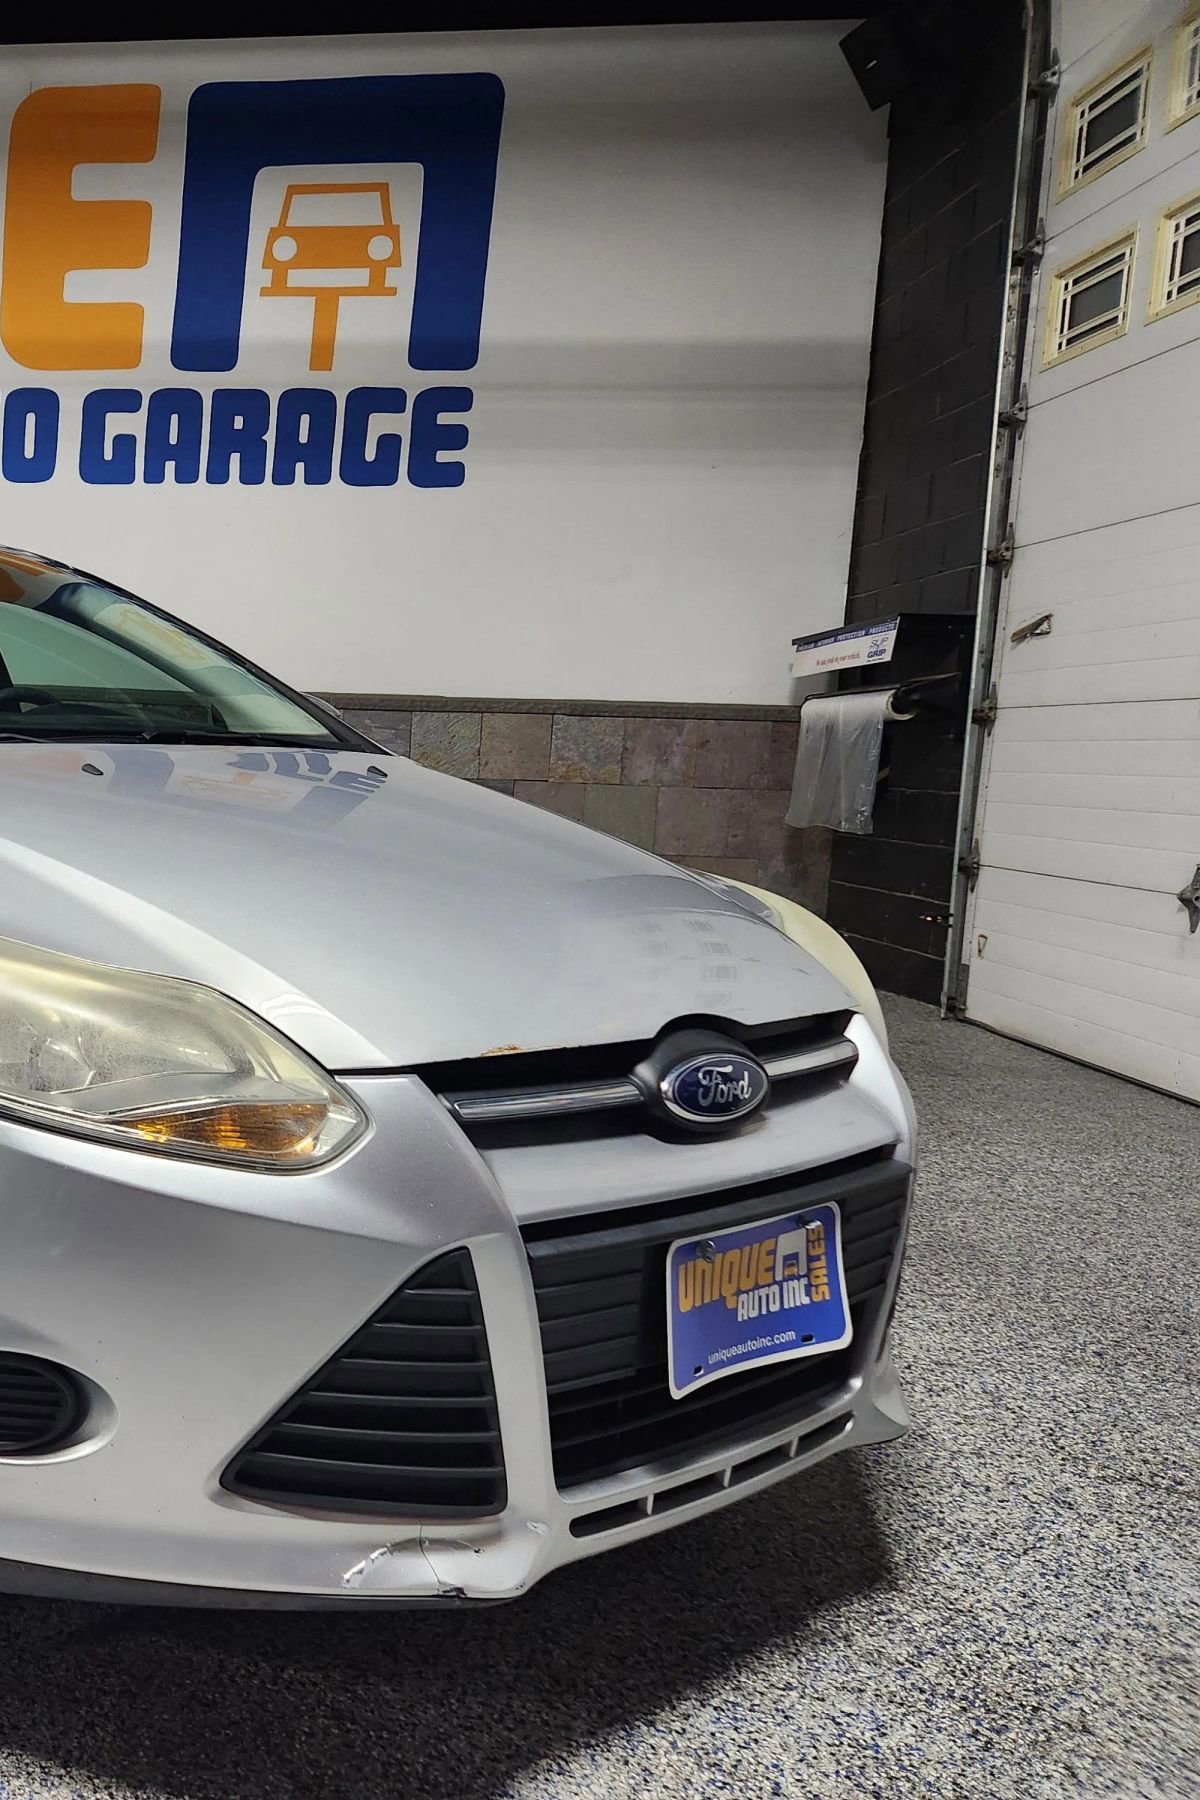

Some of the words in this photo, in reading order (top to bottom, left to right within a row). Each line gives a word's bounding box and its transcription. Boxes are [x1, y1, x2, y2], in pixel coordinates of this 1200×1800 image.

[79, 387, 472, 488] GARAGE
[867, 648, 887, 659] GRIP
[698, 1065, 752, 1107] Ford
[678, 1237, 777, 1314] UNIQUE
[807, 1223, 832, 1303] SALES
[737, 1284, 781, 1322] AUTO
[783, 1277, 811, 1309] INC
[708, 1330, 797, 1364] uniqueautoinc.com
